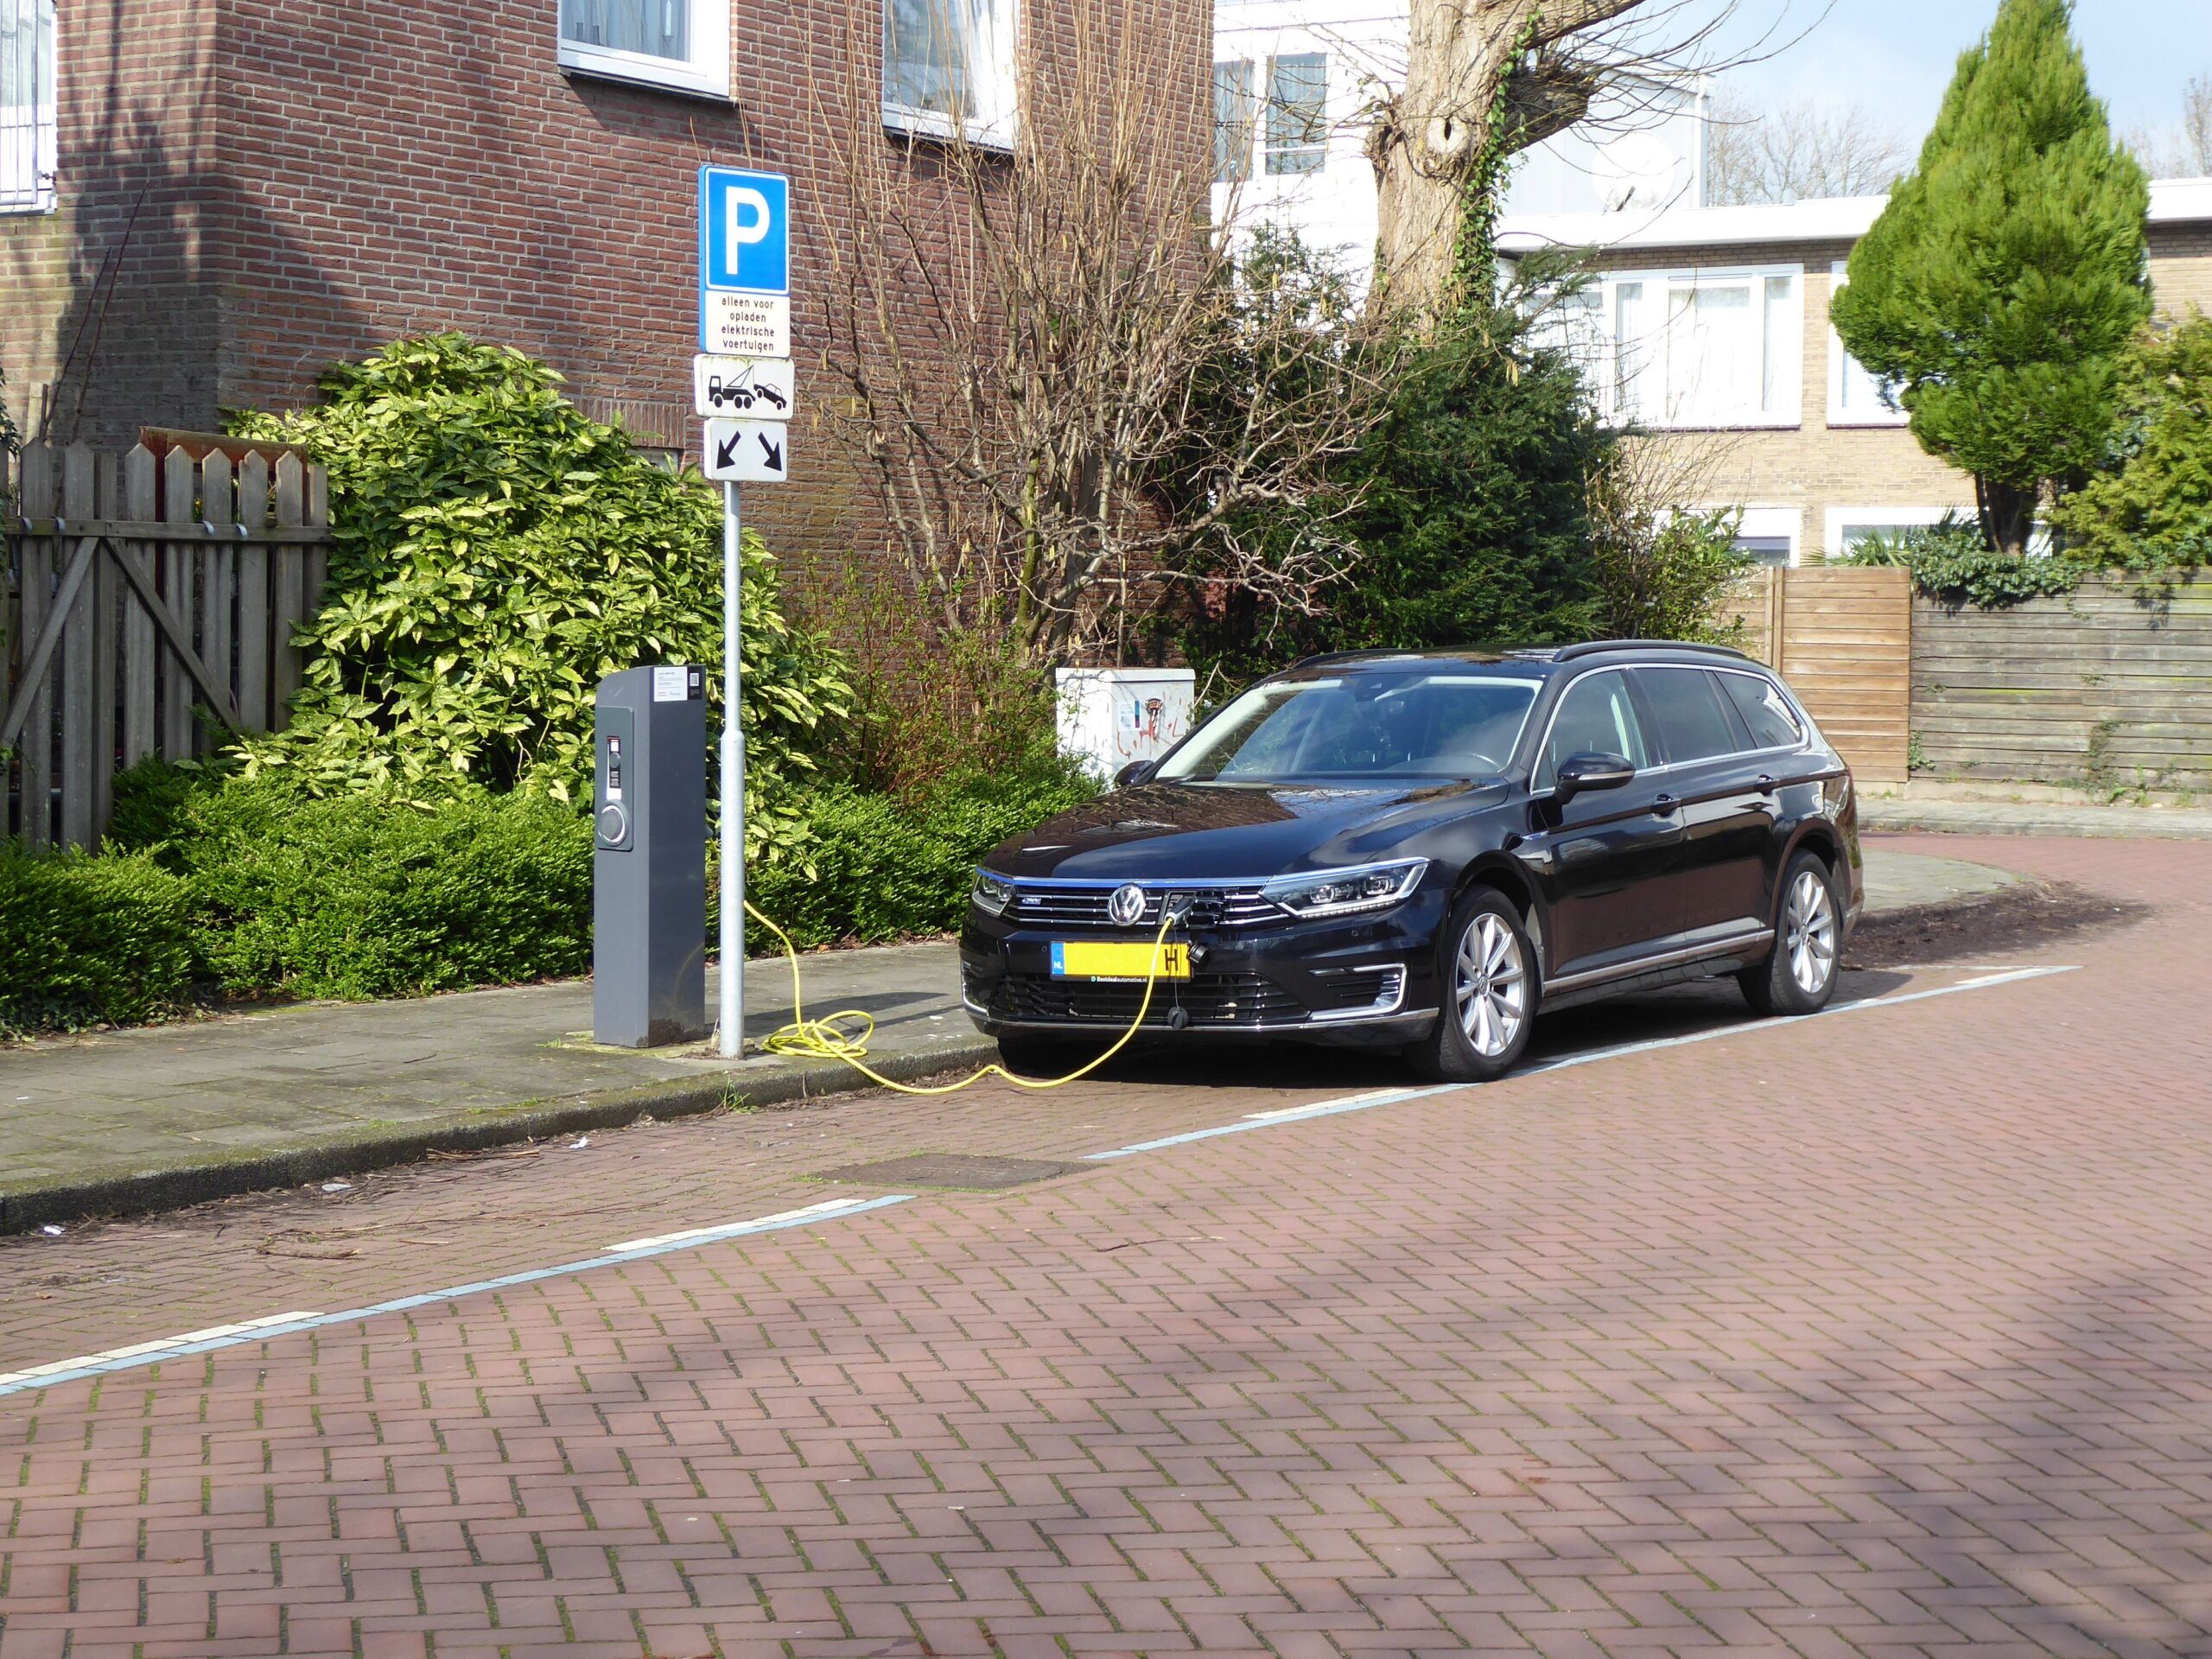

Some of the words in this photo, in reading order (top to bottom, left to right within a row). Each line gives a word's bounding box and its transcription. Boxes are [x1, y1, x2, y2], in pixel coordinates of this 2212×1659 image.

[726, 185, 771, 276] P
[721, 296, 750, 308] alleen
[753, 300, 774, 309] voor
[730, 311, 766, 322] opladen
[721, 324, 775, 337] elektrische
[722, 340, 774, 353] voertuigen
